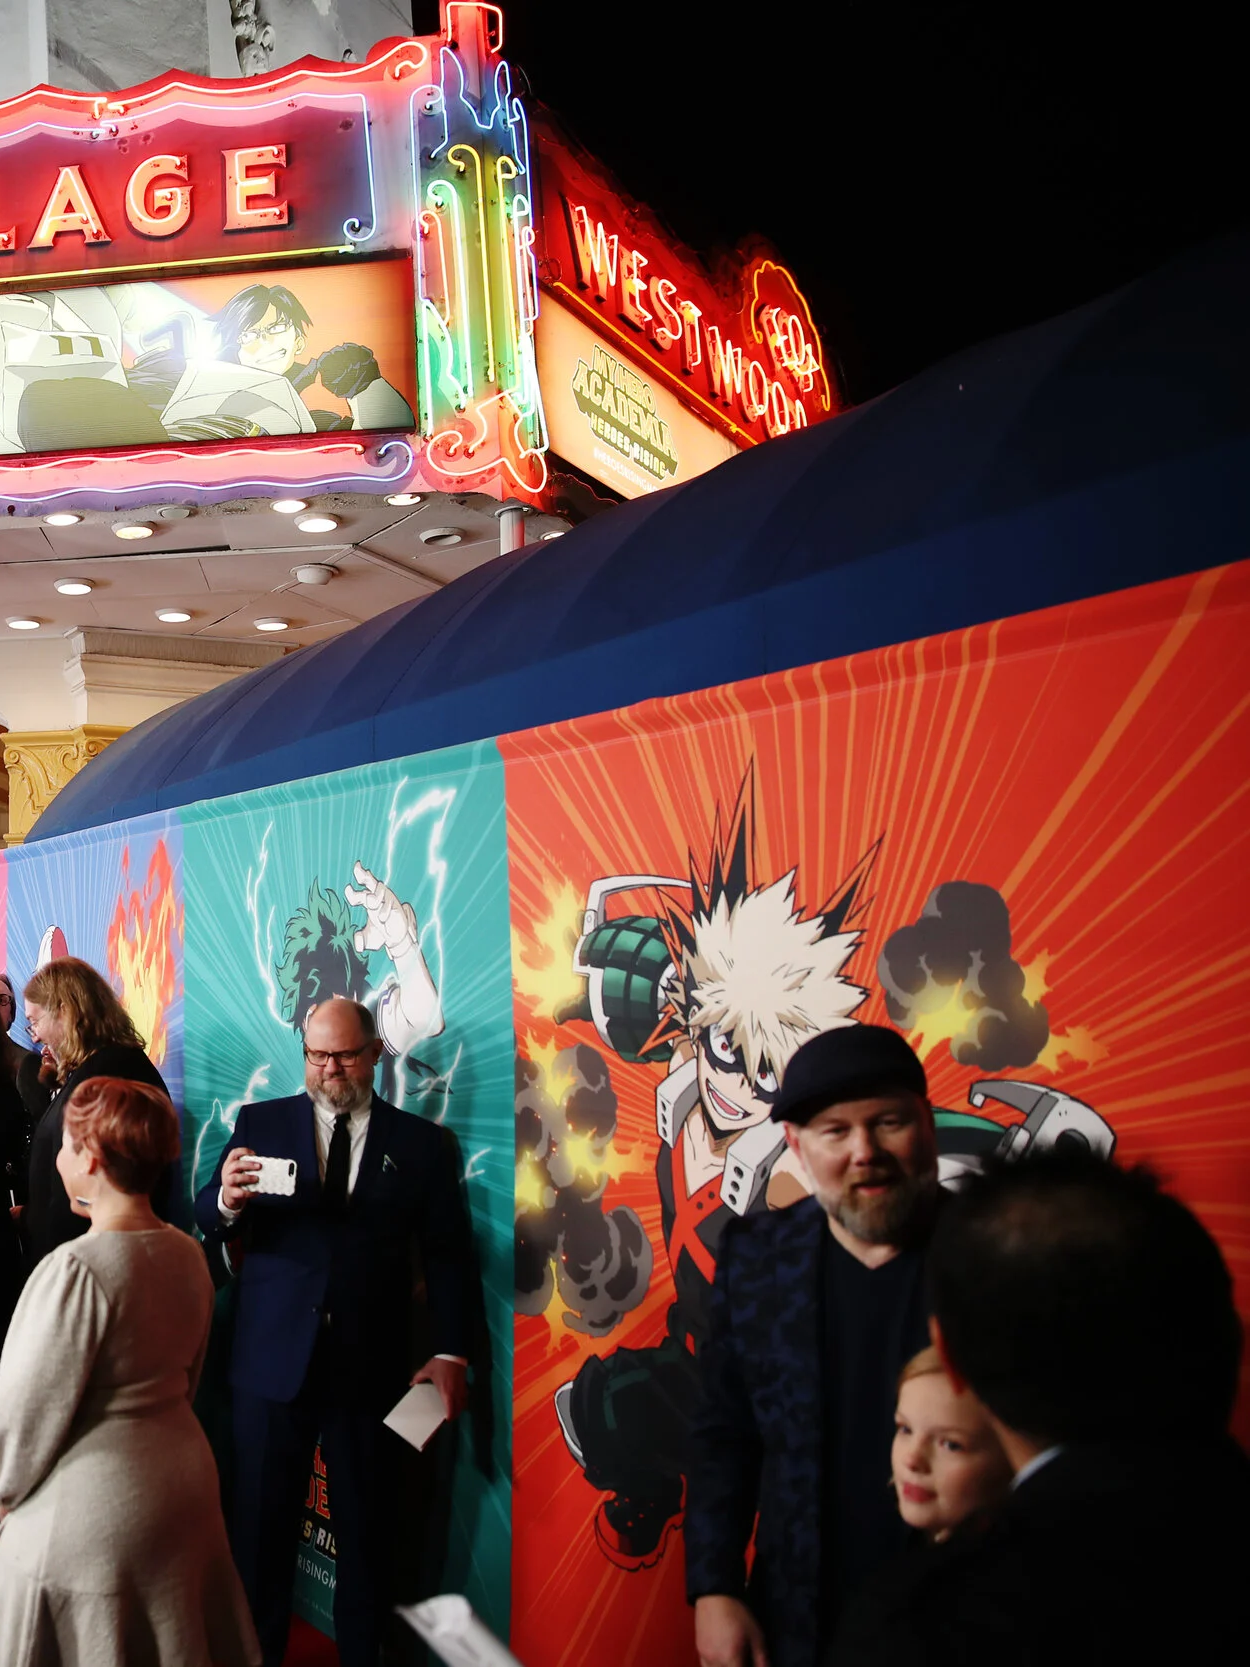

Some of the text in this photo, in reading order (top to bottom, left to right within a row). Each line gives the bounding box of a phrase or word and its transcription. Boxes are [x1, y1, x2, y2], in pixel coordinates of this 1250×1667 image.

[594, 345, 617, 383] MY
[573, 360, 677, 462] ACADEMIA
[590, 411, 631, 453] HEROES
[633, 441, 667, 477] RISING
